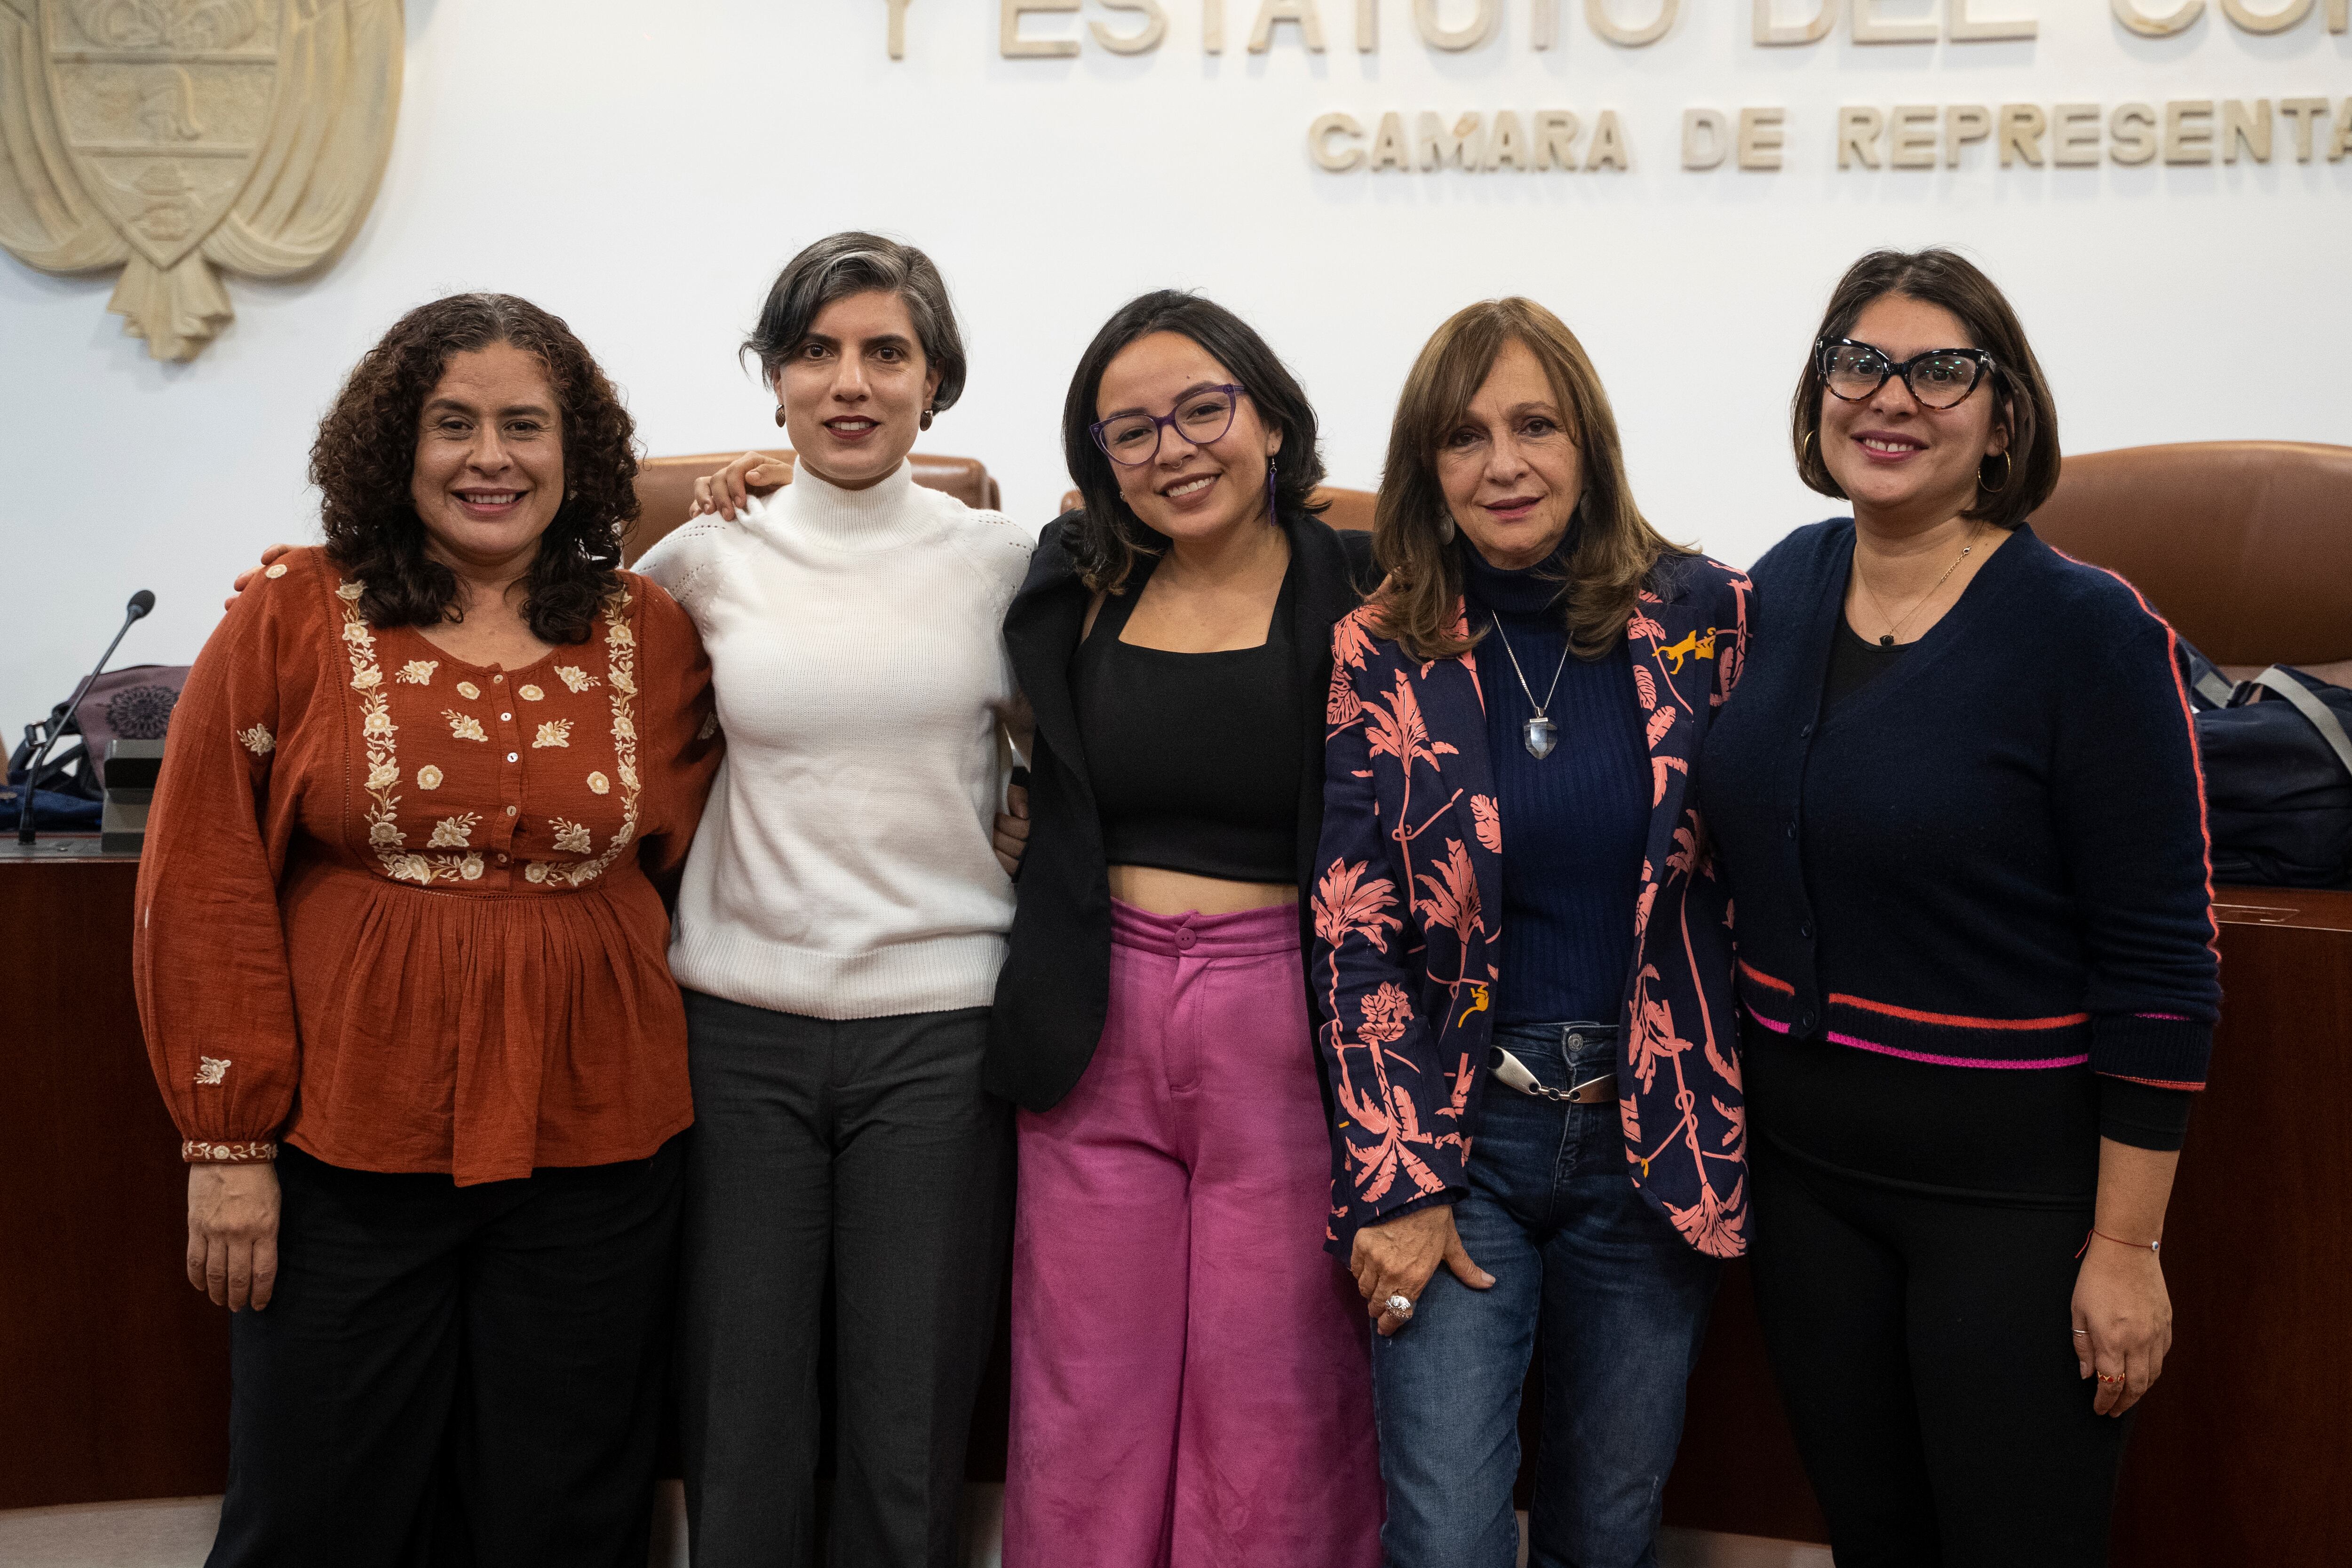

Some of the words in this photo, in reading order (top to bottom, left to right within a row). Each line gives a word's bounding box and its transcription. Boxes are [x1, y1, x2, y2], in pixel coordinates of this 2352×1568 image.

[1308, 110, 1629, 174] CAMARA
[1681, 107, 1787, 172] DE
[1837, 97, 2352, 171] REPRESENTA
